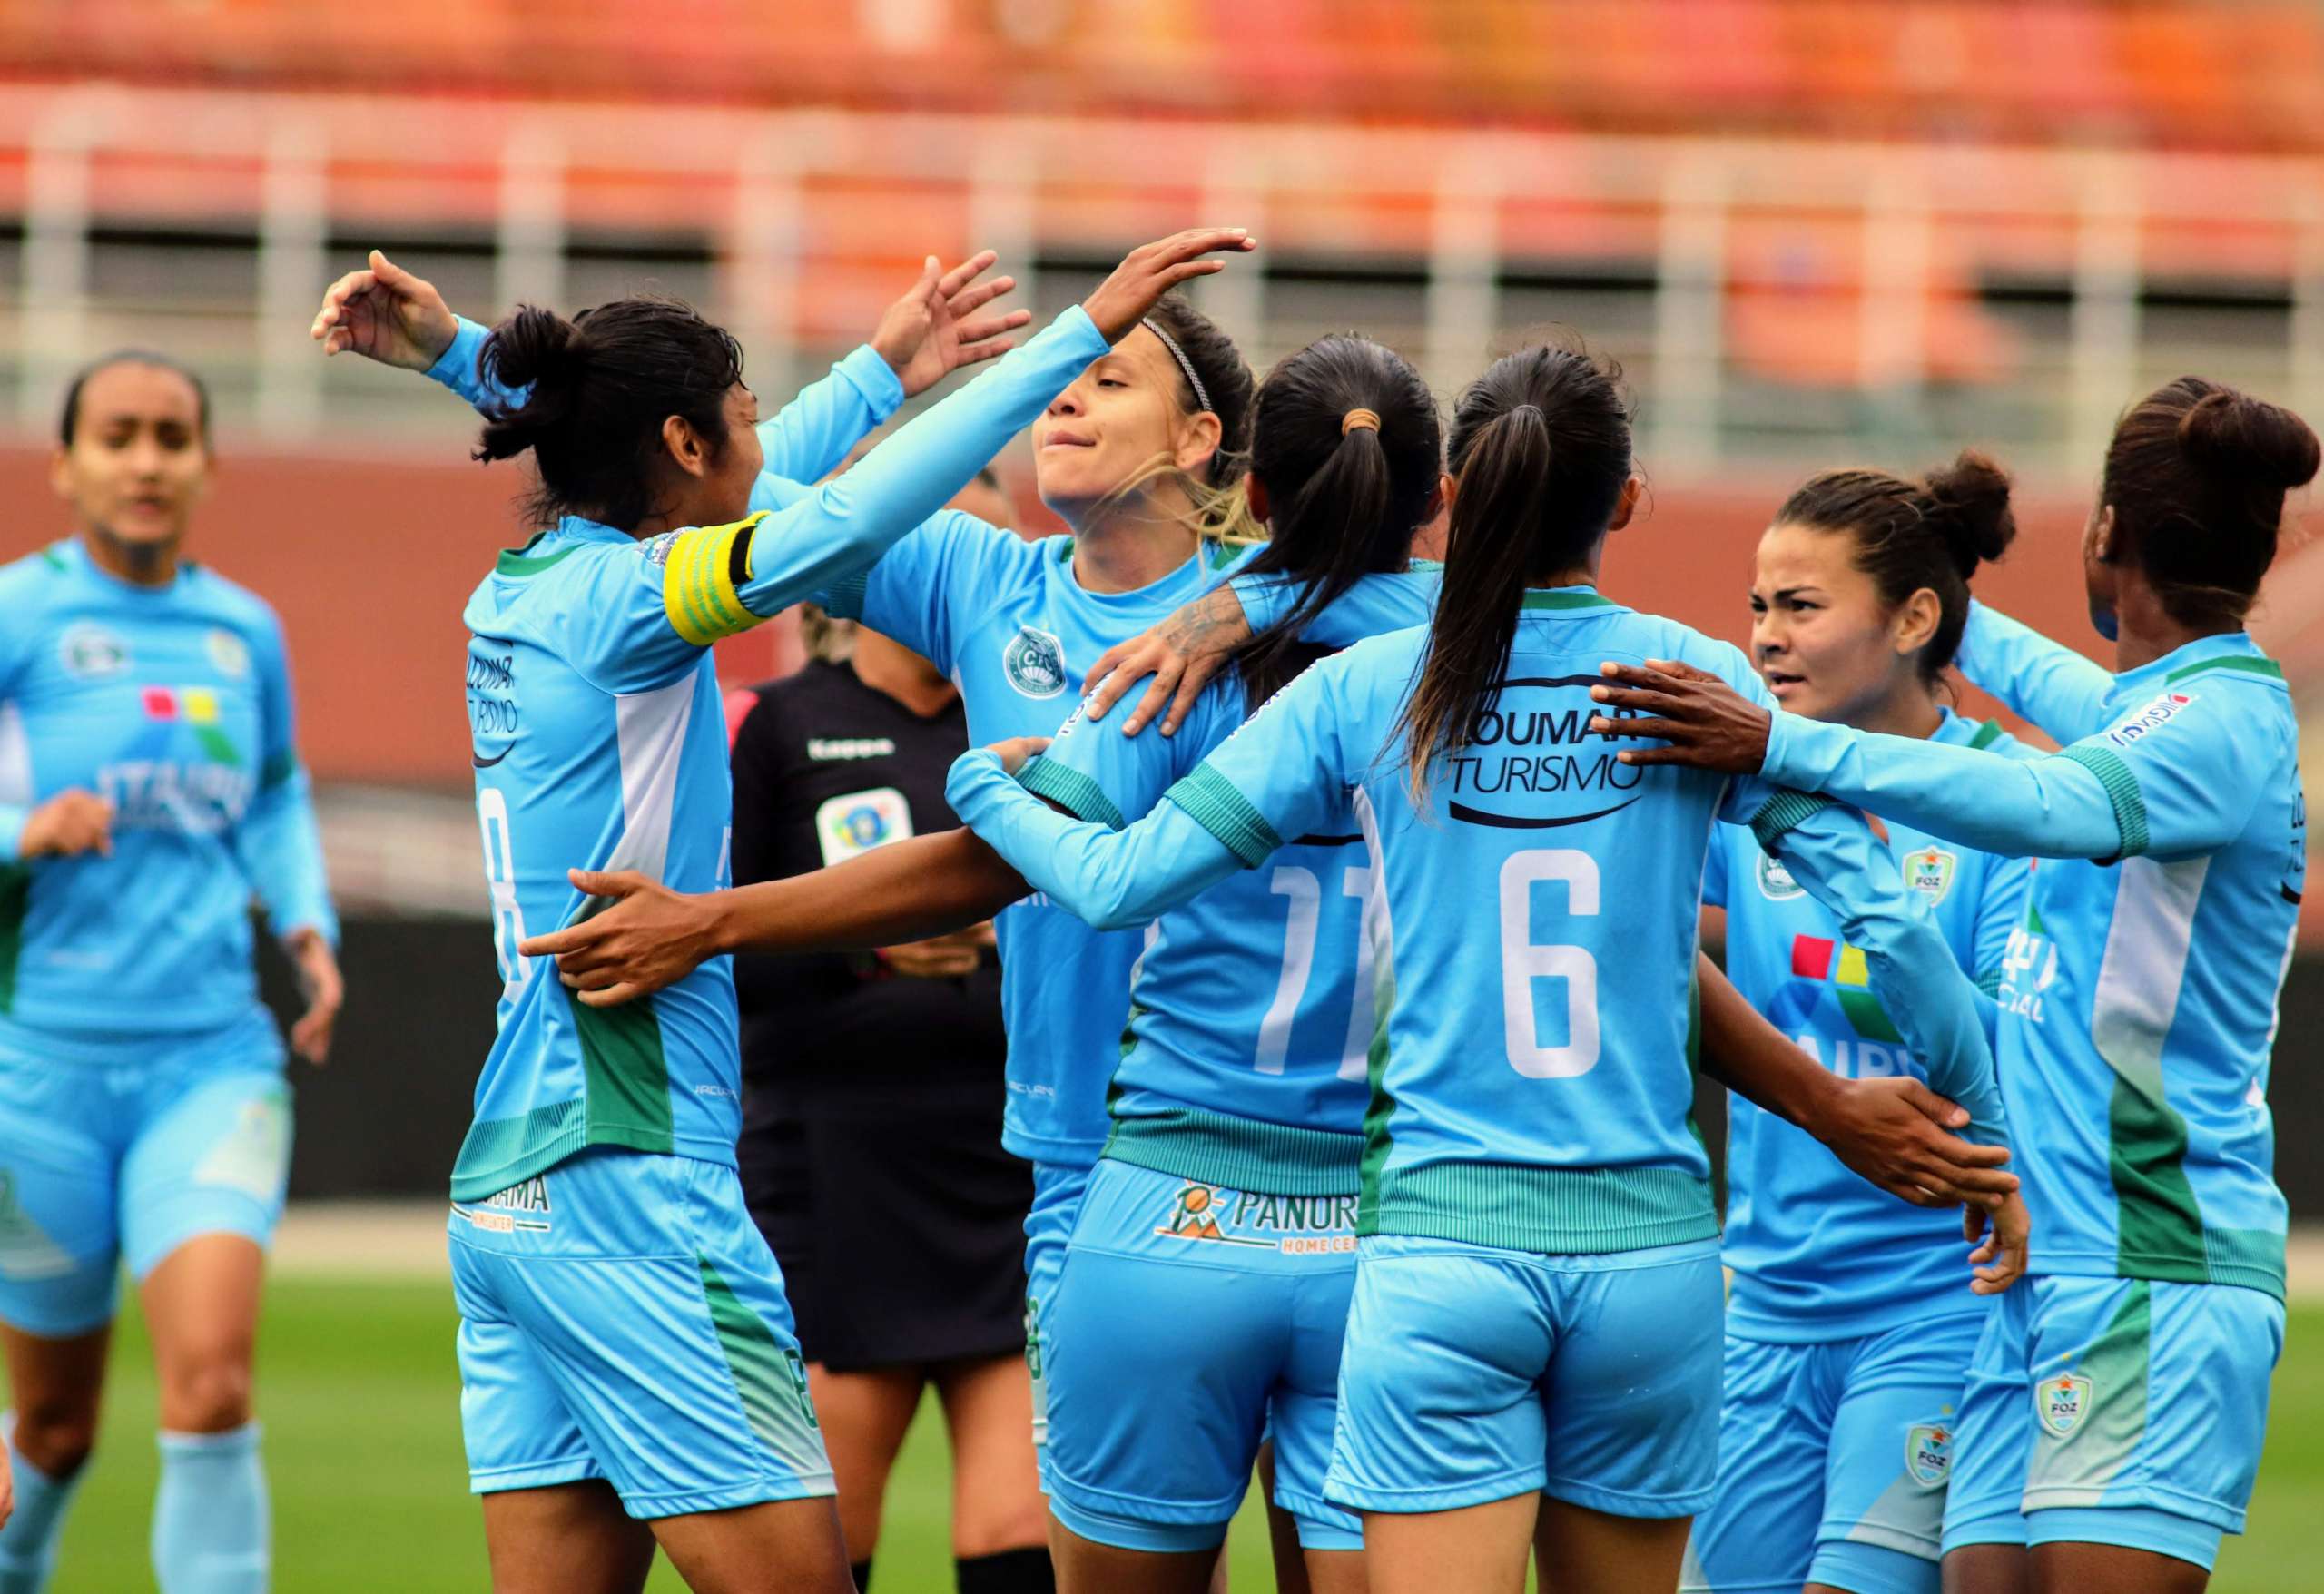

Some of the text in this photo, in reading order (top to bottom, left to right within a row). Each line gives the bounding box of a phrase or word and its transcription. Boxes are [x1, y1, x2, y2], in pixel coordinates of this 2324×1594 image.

[1452, 707, 1637, 746] OUMAR
[1447, 754, 1642, 795] TURISMO
[1915, 877, 1941, 887] FOZ
[1500, 850, 1600, 1078] 6
[1284, 1238, 1328, 1252] HOME
[2052, 1402, 2077, 1412] FOZ
[1917, 1451, 1946, 1467] FOZ
